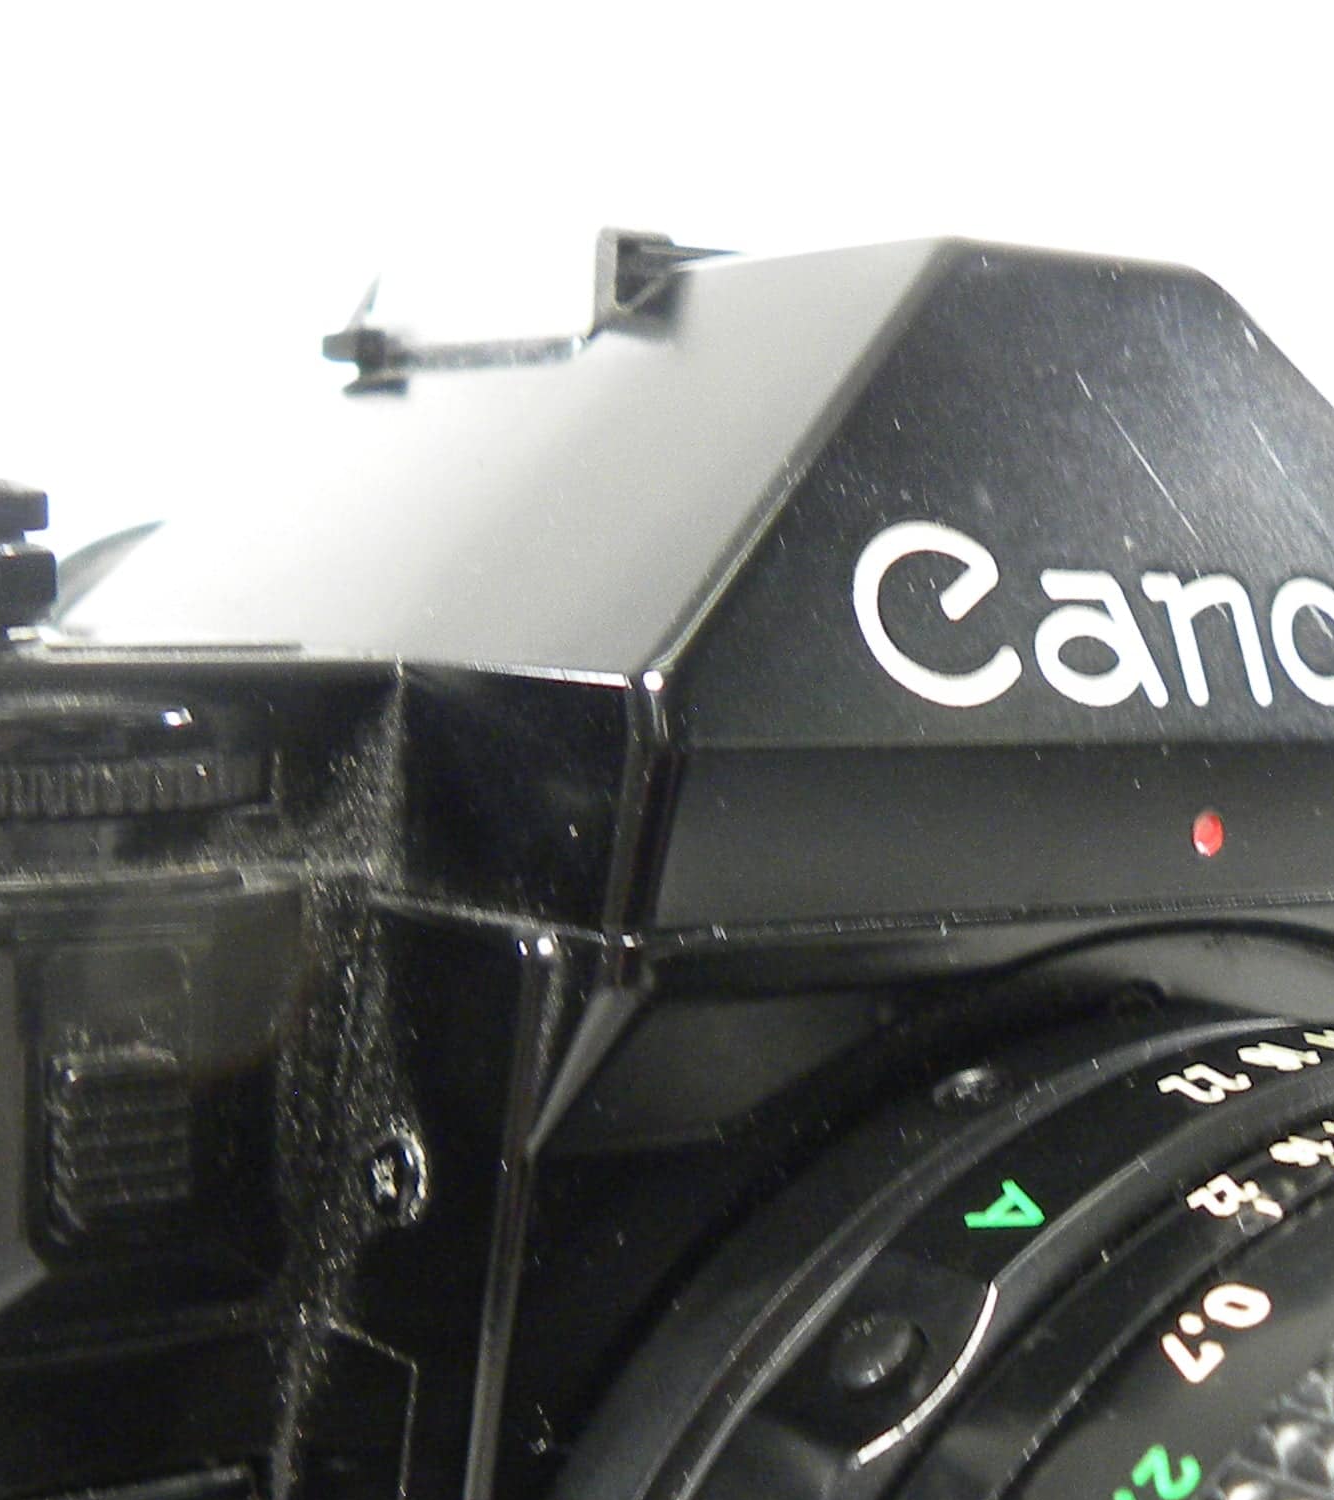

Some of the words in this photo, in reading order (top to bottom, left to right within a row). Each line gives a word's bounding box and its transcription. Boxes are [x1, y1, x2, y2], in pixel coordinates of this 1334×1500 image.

[1157, 1062, 1253, 1104] 22
[964, 1178, 1046, 1228] A
[1161, 1283, 1271, 1384] 0.7
